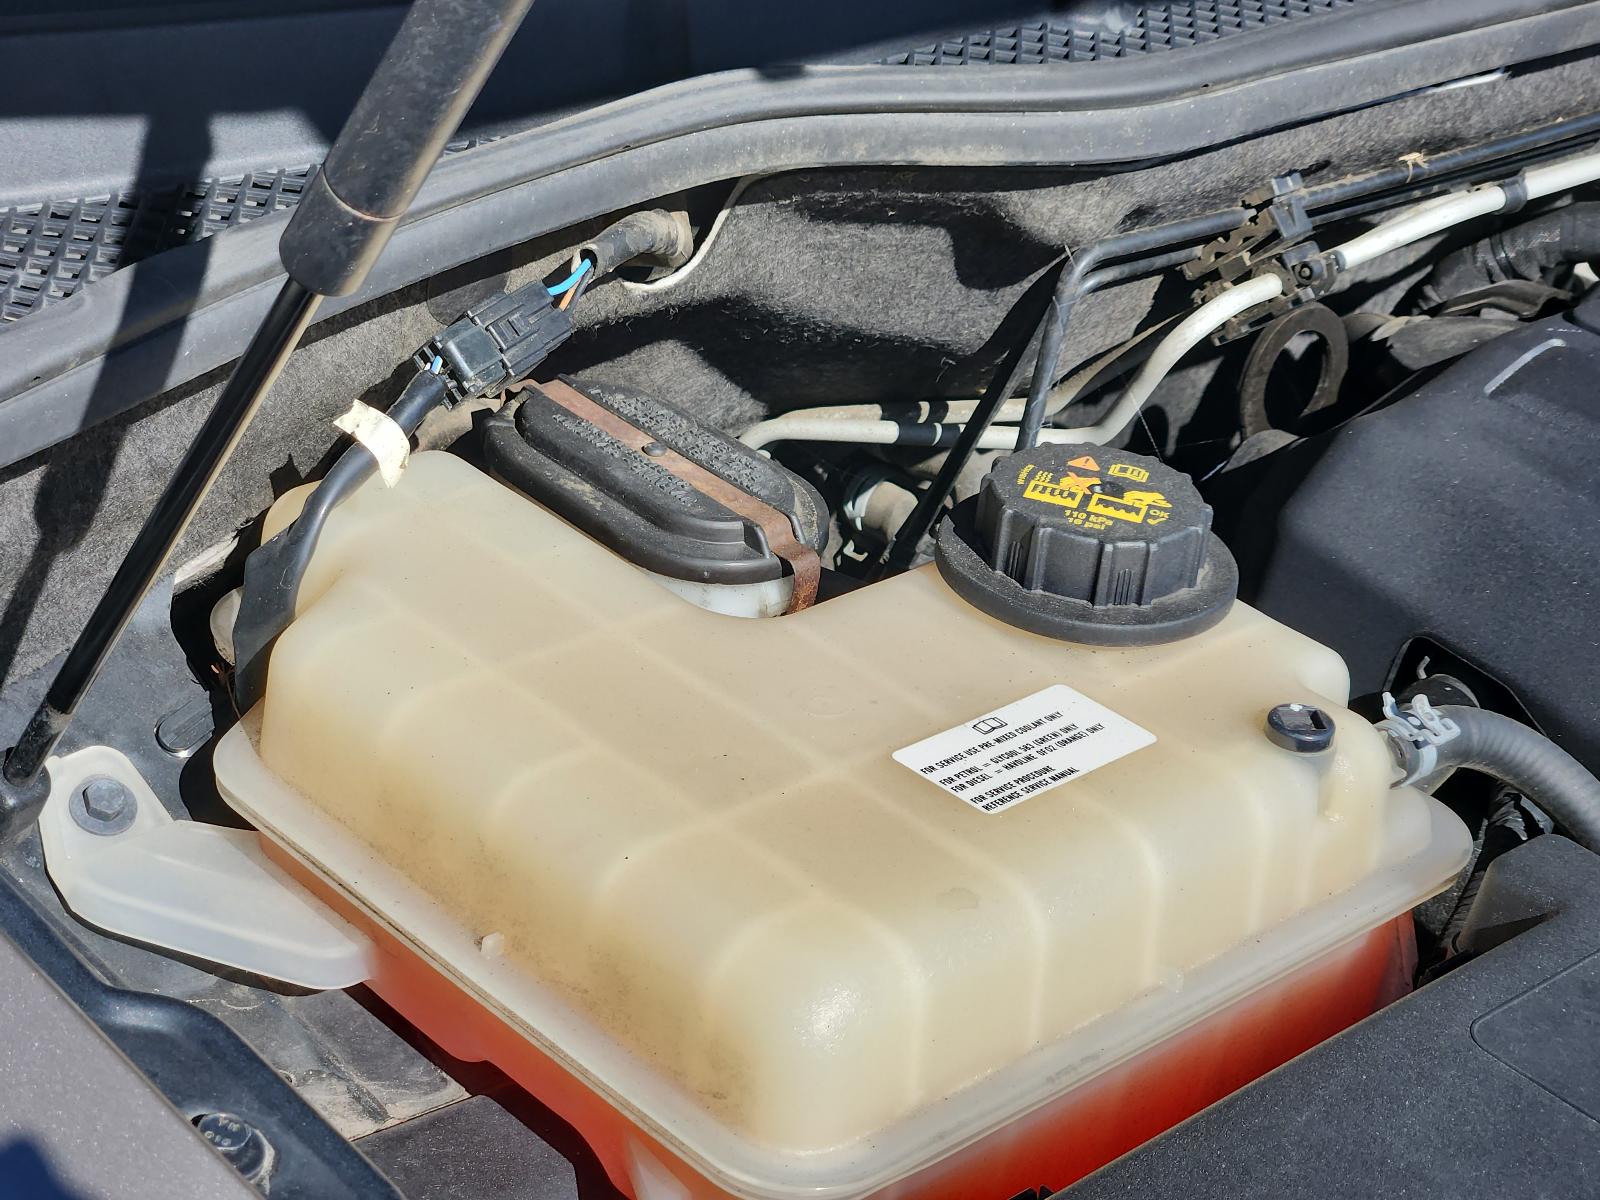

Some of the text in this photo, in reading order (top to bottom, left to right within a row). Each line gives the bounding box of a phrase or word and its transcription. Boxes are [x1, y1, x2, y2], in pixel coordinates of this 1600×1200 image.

[1064, 509, 1114, 526] 110 kPa
[1083, 521, 1106, 530] psi
[1150, 509, 1170, 519] OK
[920, 711, 1063, 775] FOR SERVICE USE PRE-MIXED COOLANT ONLY
[938, 776, 957, 786] FOR
[953, 765, 983, 780] PETROL
[989, 749, 1022, 764] GLYCOOL
[1032, 731, 1063, 746] (GREEN)
[1059, 723, 1079, 734] ONLY
[950, 783, 969, 793] FOR
[965, 773, 993, 786] DIESEL
[1002, 753, 1038, 771] HAVOLINE
[1054, 731, 1089, 748] (ORANGE)
[1085, 723, 1105, 734] ONLY
[970, 765, 1056, 804] FOR SERVICE PROCEDURE
[981, 767, 1080, 811] REFERENCE SERVICE MANUAL
